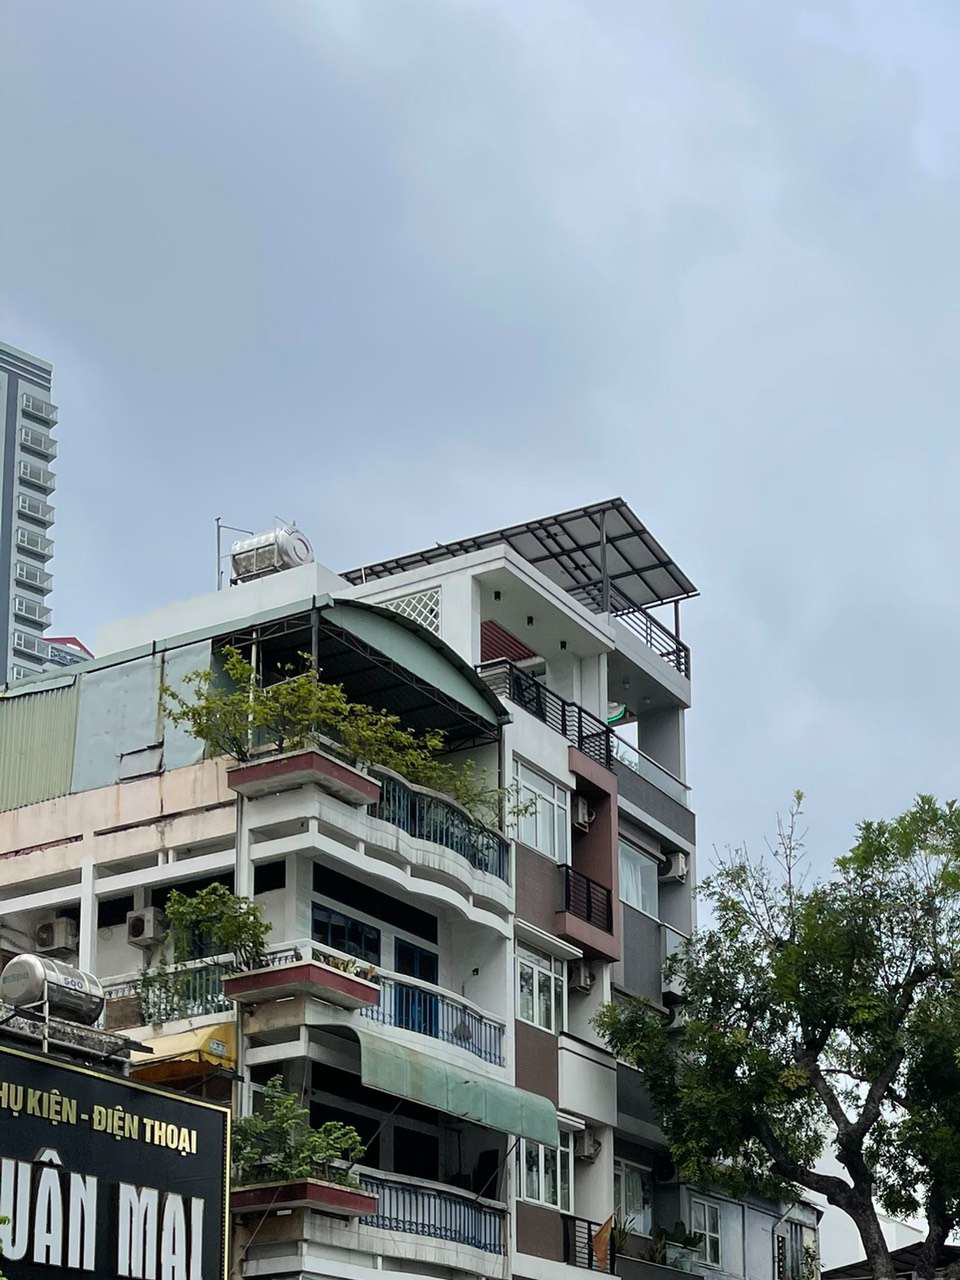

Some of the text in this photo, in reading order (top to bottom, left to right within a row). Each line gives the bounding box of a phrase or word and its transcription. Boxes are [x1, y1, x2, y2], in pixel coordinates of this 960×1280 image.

[0, 1082, 24, 1117] HỤ
[27, 1088, 77, 1125] KIỆN
[93, 1105, 139, 1140] ĐIỆN
[143, 1118, 198, 1156] THOẠI
[0, 1147, 98, 1271] UÂN
